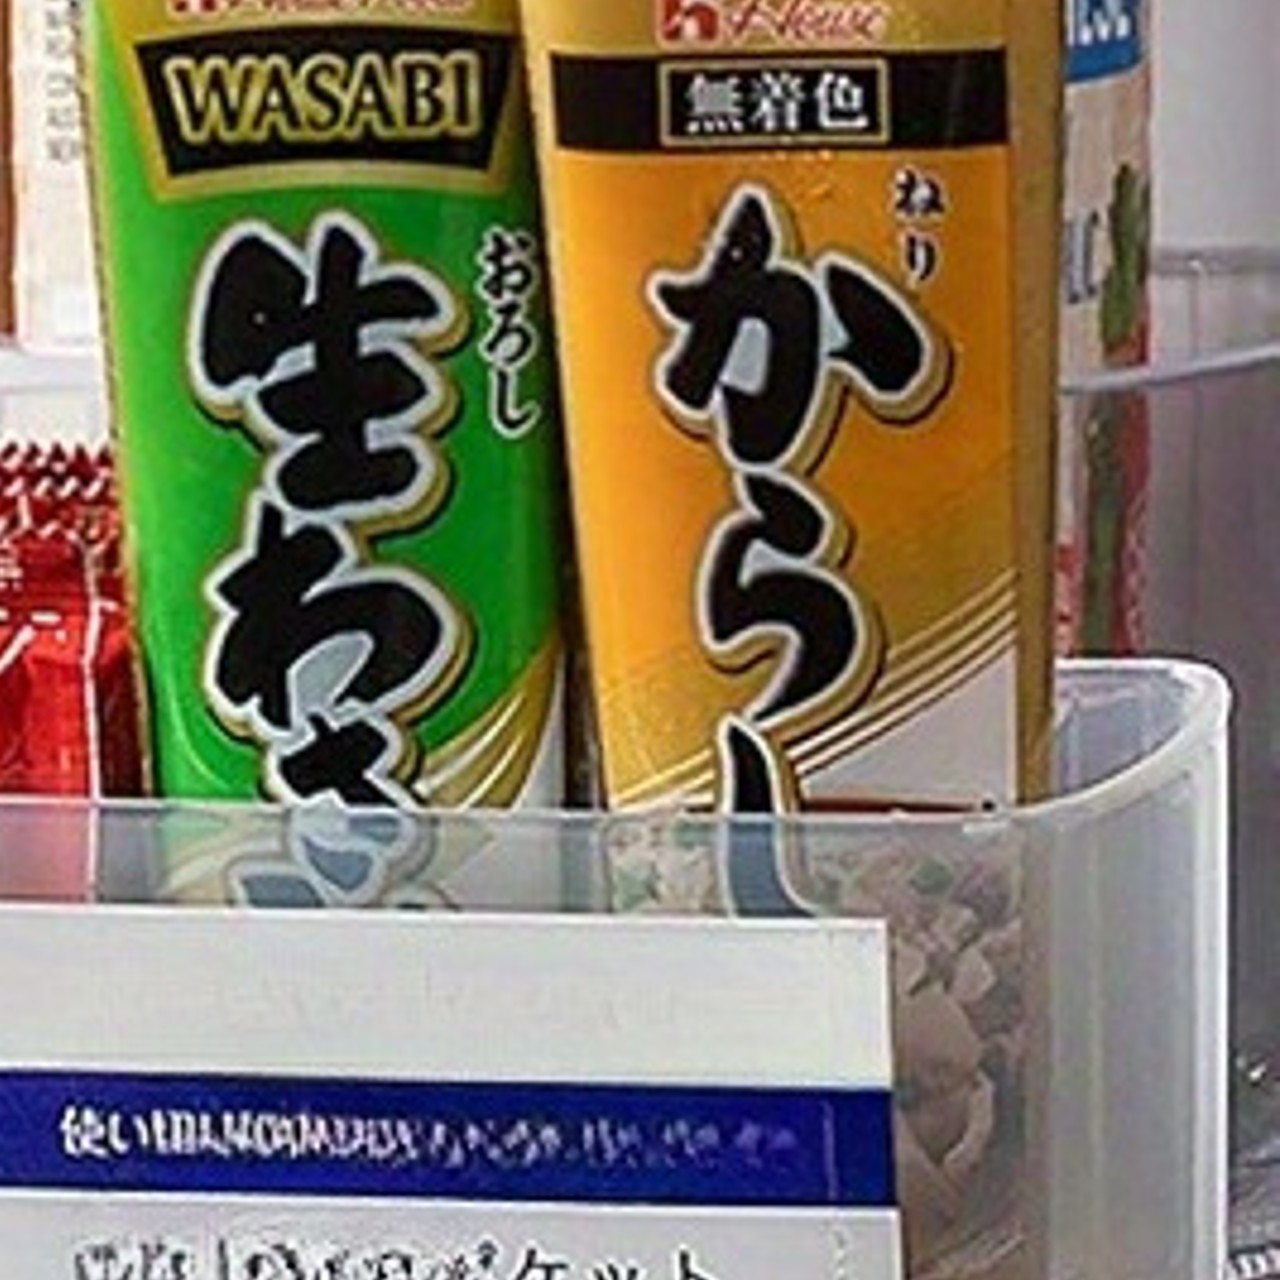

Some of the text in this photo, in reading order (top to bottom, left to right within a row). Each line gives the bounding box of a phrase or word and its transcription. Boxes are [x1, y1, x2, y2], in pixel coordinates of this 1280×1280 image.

[164, 54, 482, 144] WASABI
[482, 226, 538, 434] おろし
[197, 218, 446, 910] 生わさ
